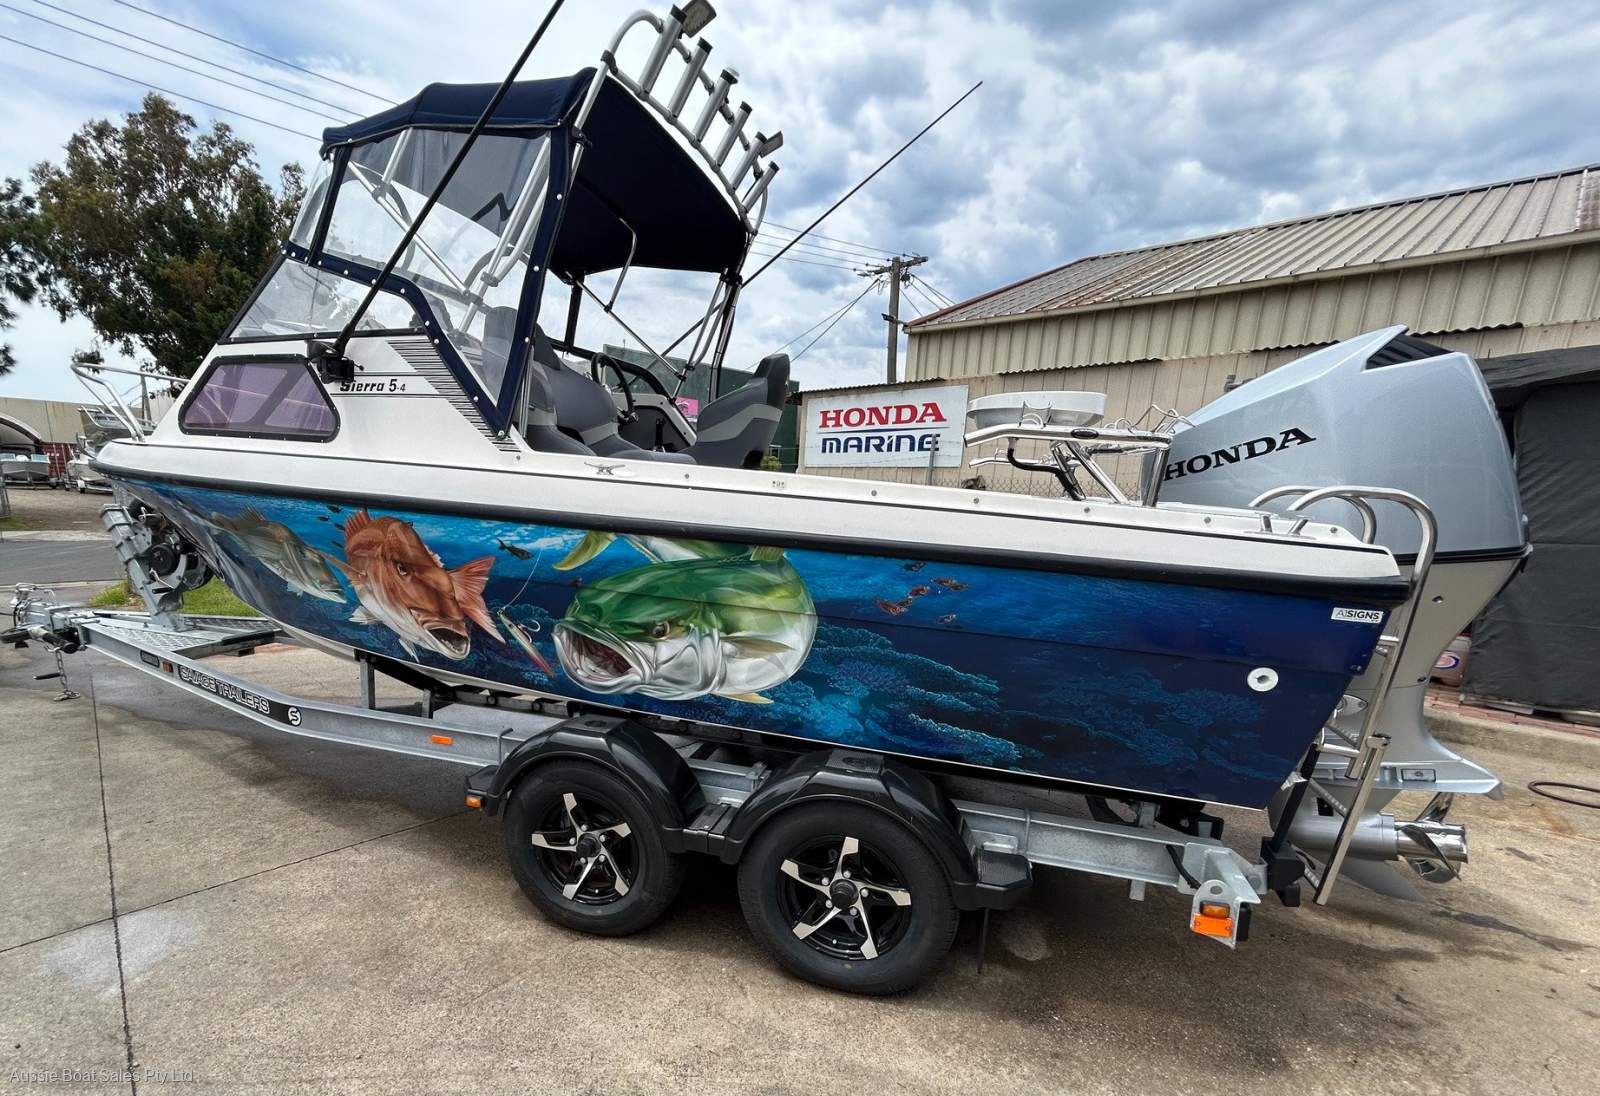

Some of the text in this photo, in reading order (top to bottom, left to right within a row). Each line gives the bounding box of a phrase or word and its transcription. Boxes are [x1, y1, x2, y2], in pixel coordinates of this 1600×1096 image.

[340, 380, 385, 392] Sierra
[819, 402, 947, 428] HONDA
[1164, 427, 1317, 481] HONDA
[179, 665, 271, 715] SAVAGE TRAILERS
